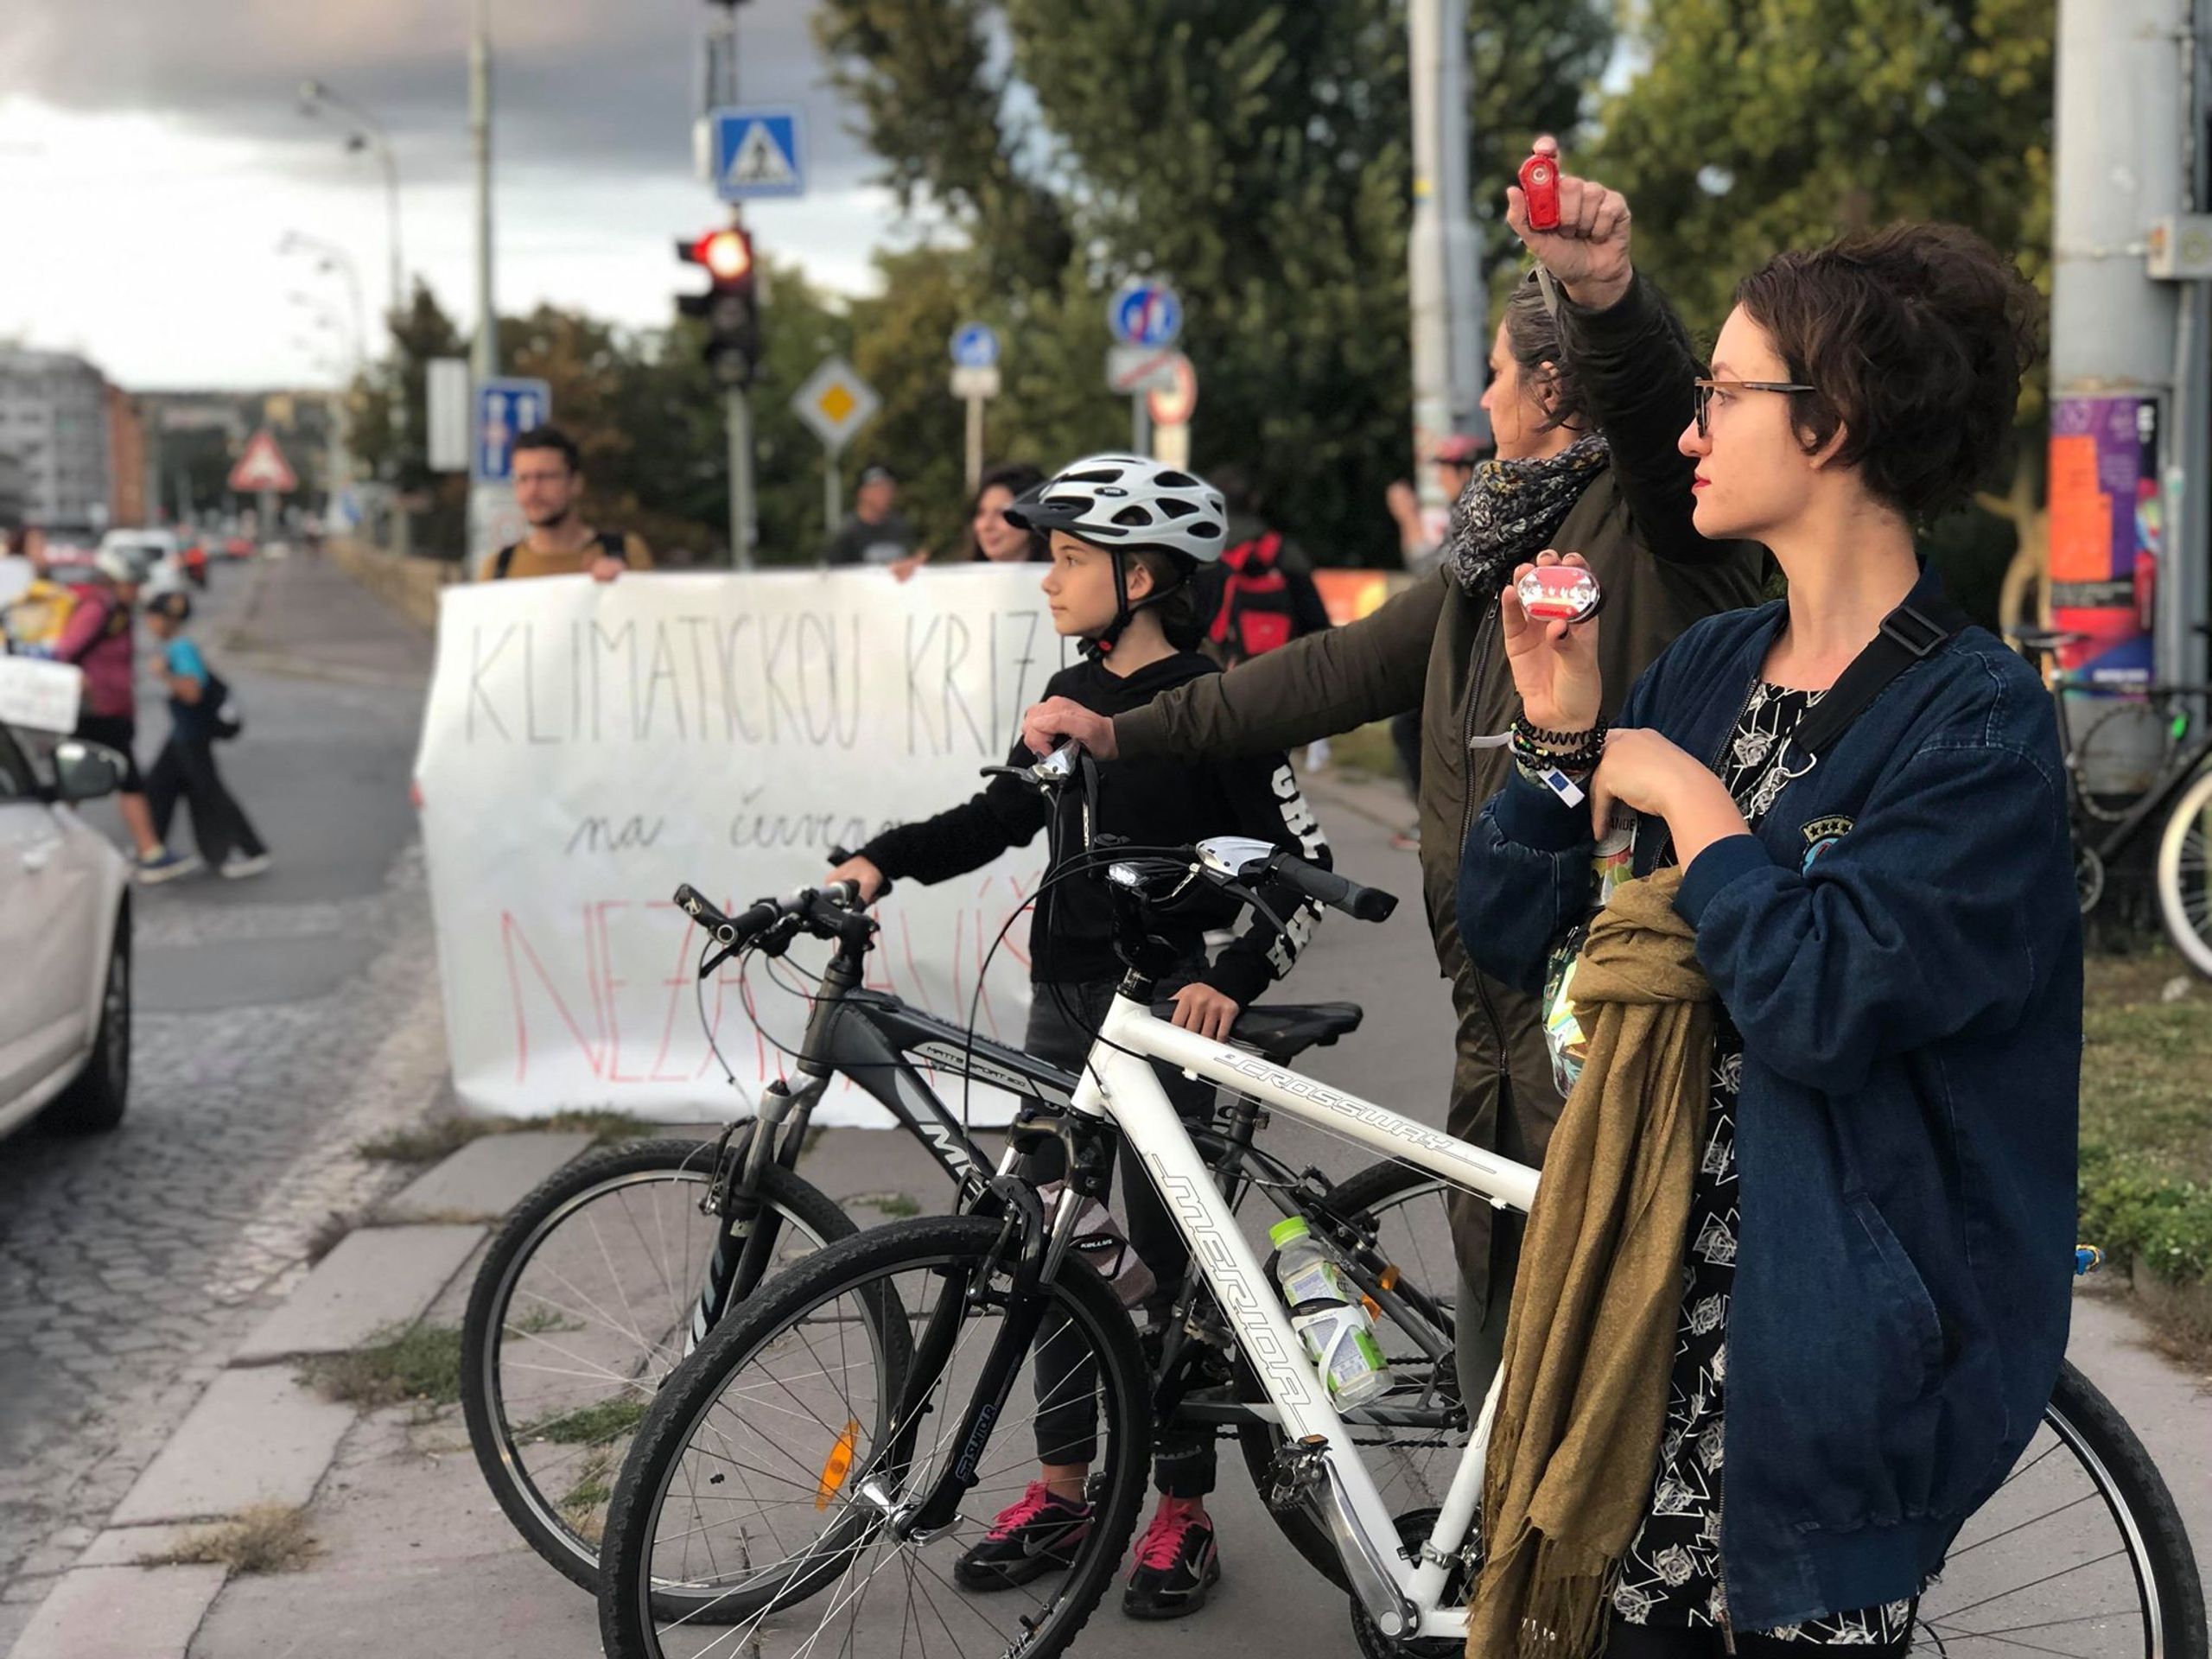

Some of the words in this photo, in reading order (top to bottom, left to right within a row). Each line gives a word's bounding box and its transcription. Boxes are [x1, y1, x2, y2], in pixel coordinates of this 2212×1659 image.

[466, 612, 861, 747] KLIMATICKOU
[566, 812, 664, 854] na
[926, 1045, 965, 1065] MATTS
[969, 1062, 1007, 1080] SPORT
[1230, 1057, 1457, 1151] CROSSWAY
[1160, 1169, 1312, 1408] MERIDA
[965, 1404, 996, 1458] SUNTOUR
